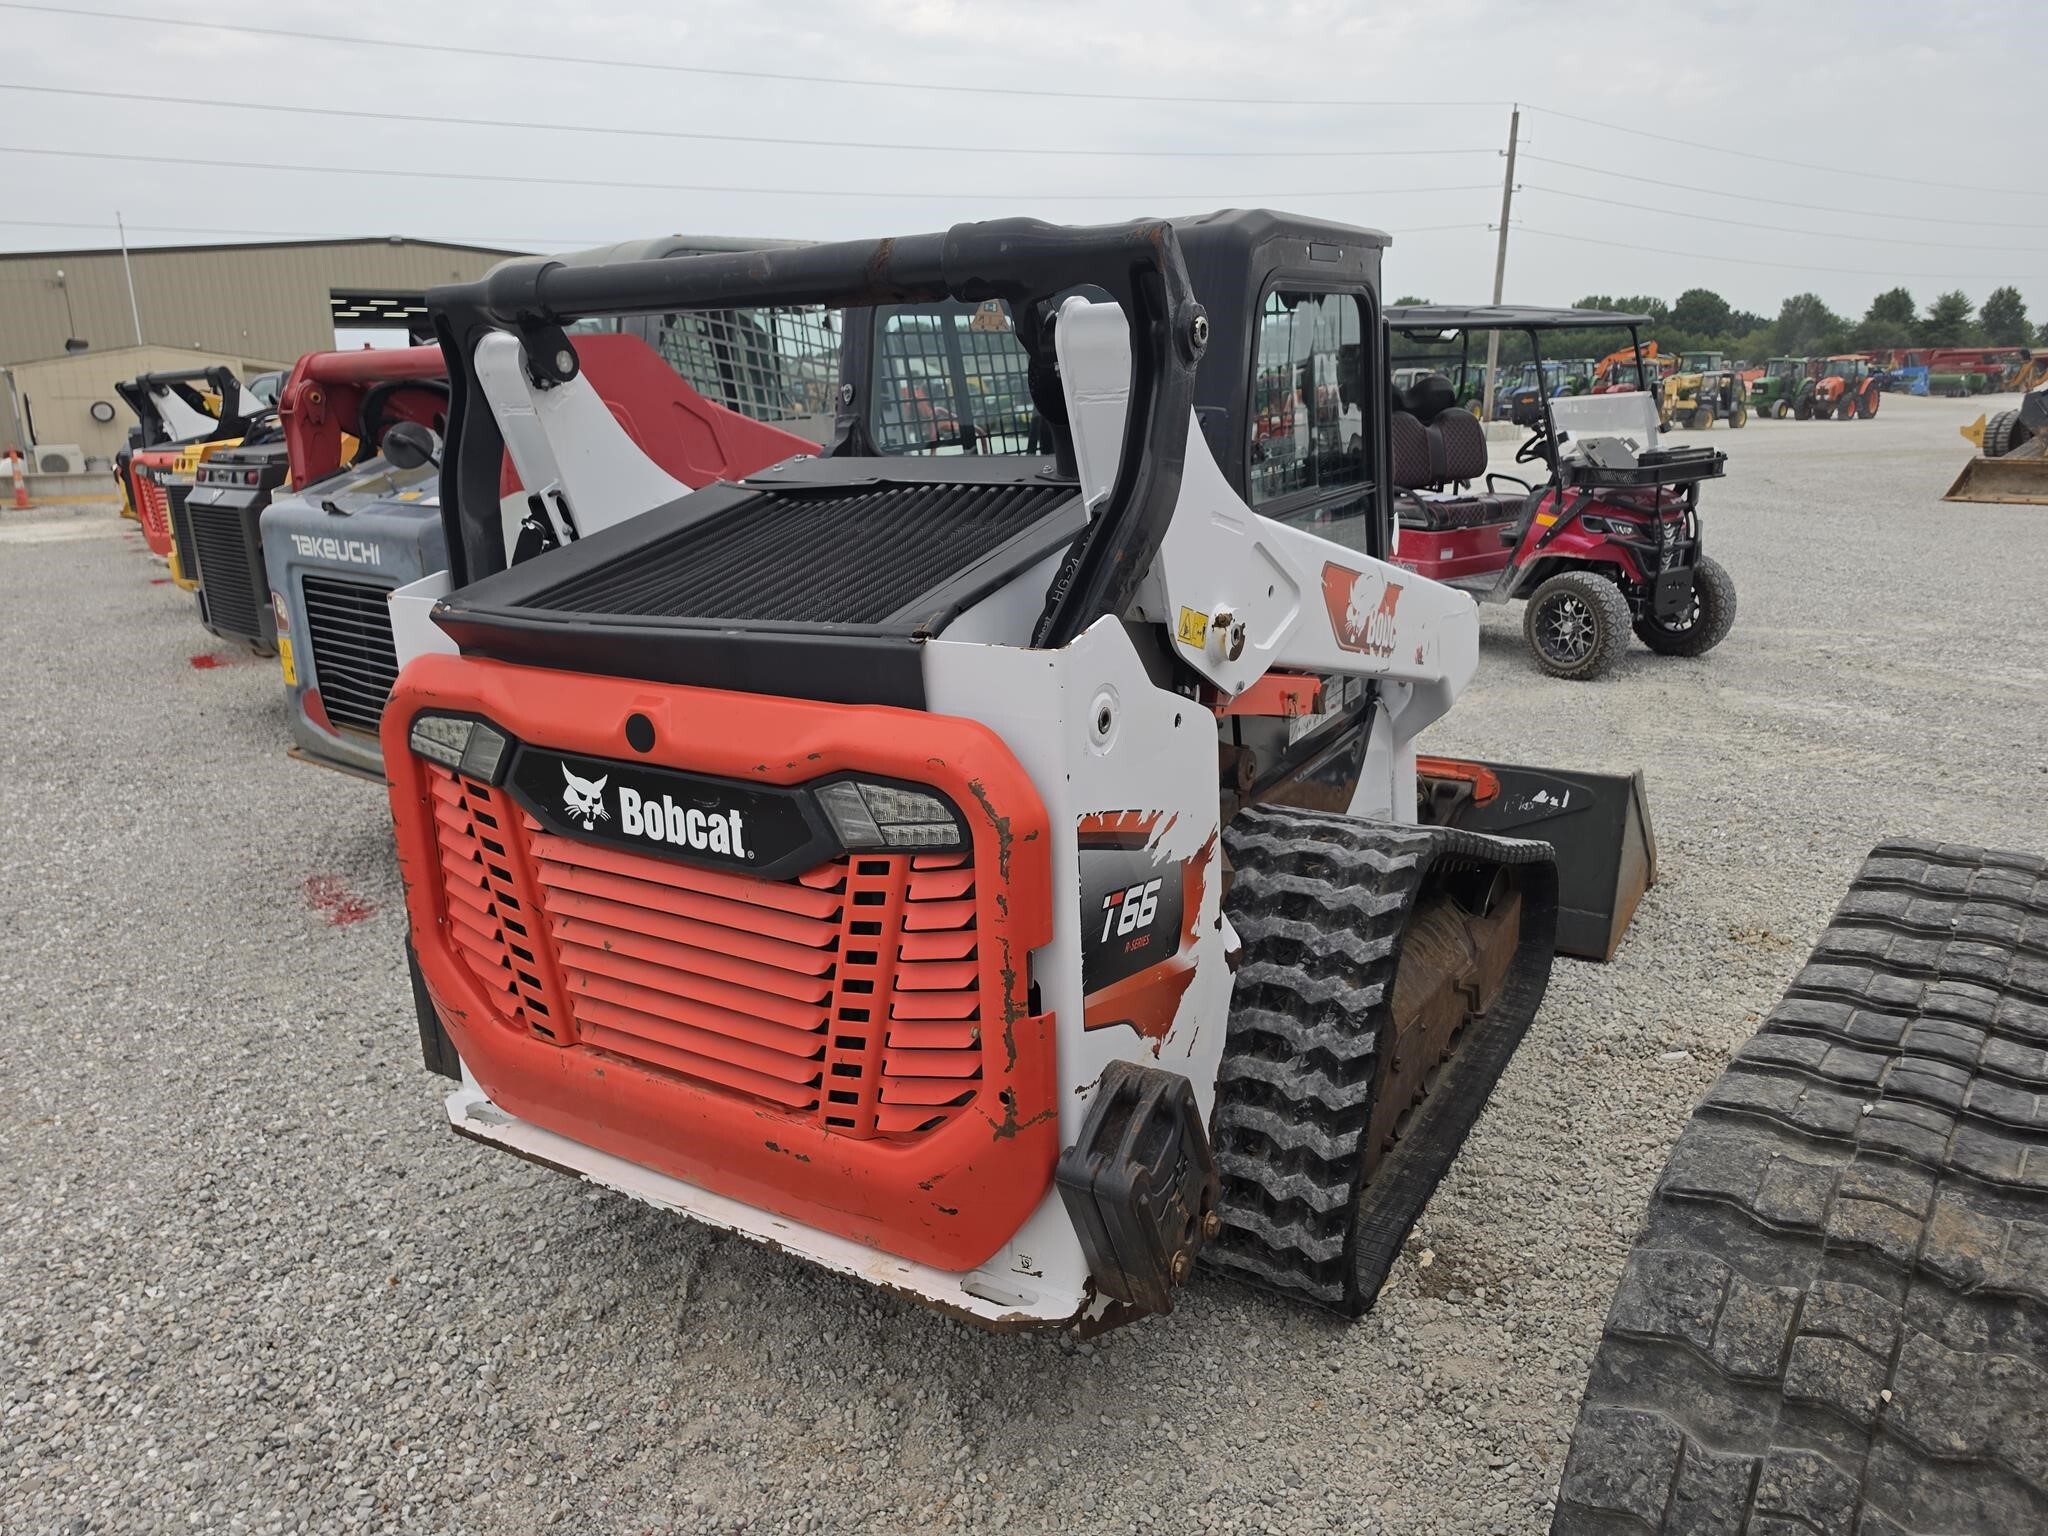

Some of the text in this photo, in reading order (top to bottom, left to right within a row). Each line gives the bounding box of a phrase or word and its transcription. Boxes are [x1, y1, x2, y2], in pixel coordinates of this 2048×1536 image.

[291, 534, 381, 566] TAKEUCHI
[618, 786, 746, 858] Bobcat
[1101, 878, 1162, 943] T66
